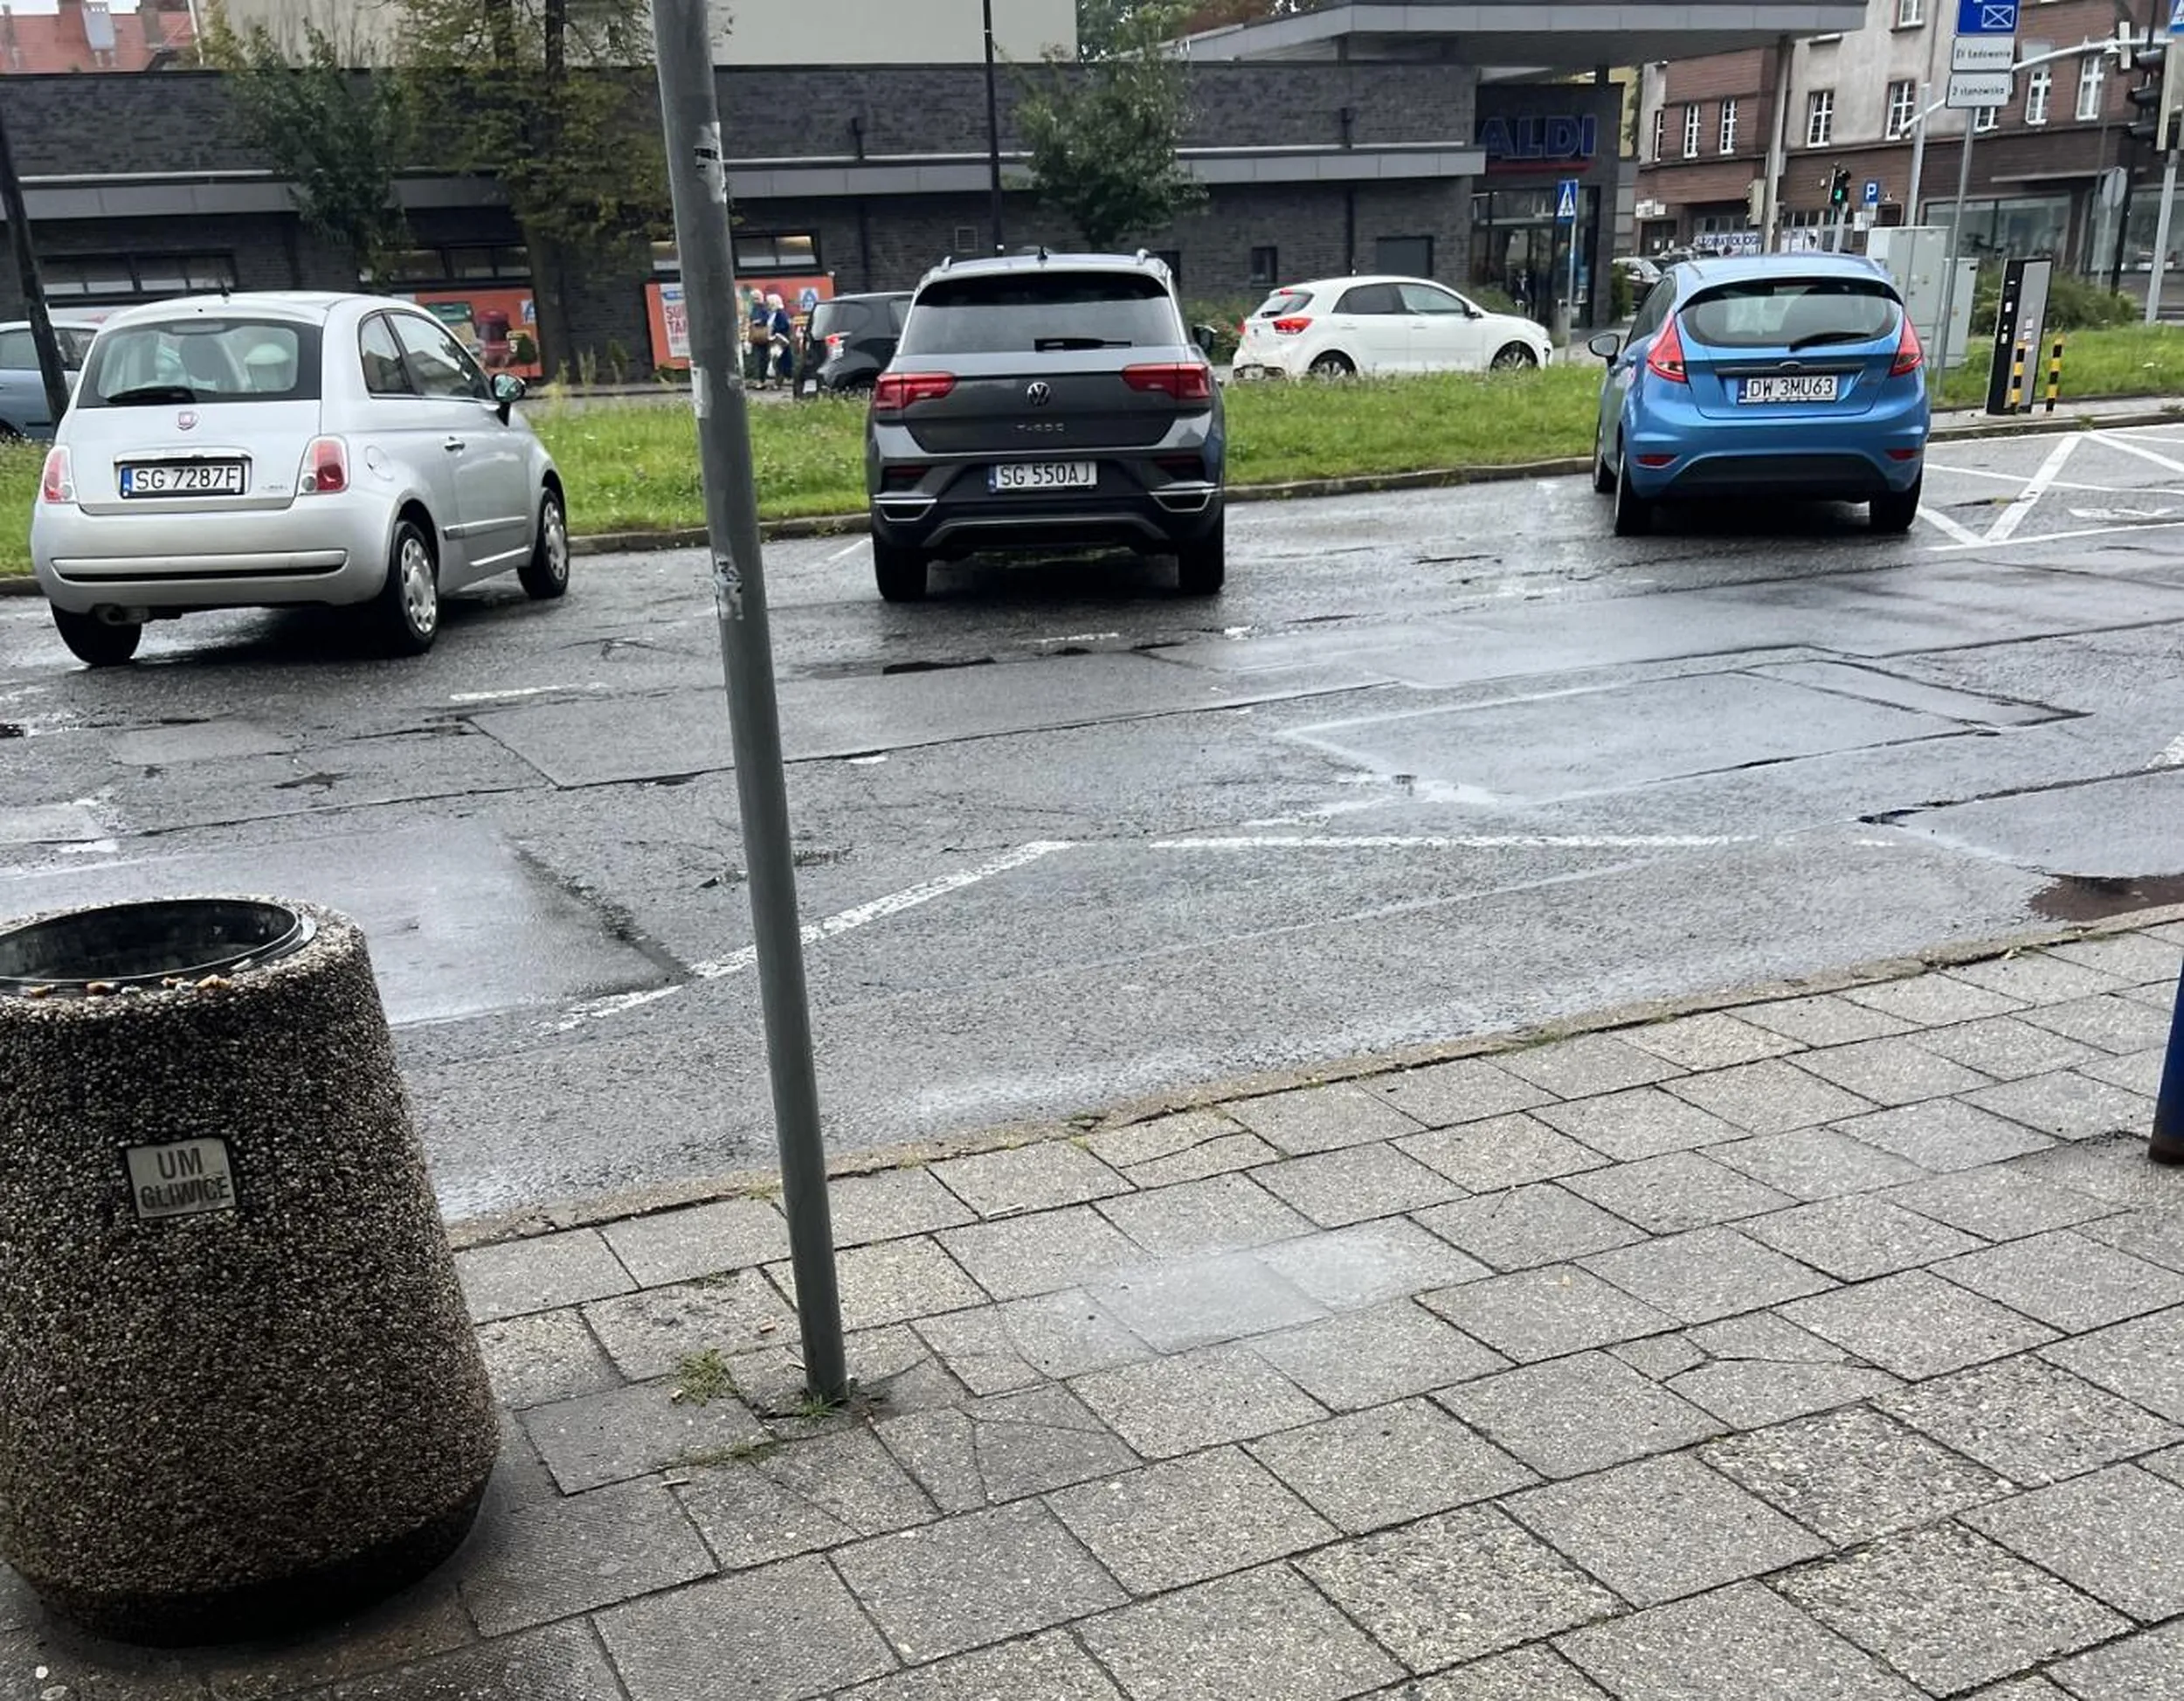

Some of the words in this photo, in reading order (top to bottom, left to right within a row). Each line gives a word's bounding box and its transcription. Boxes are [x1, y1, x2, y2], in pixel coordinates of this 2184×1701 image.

[1480, 114, 1598, 158] ALDI
[1865, 183, 1877, 200] P
[1750, 379, 1773, 398] DW
[1780, 377, 1834, 396] 3MU63
[135, 469, 165, 490] SG
[171, 467, 239, 489] 7287F
[1001, 467, 1025, 487] SG
[1032, 463, 1089, 485] 550AJ
[156, 1147, 204, 1180] UM
[141, 1171, 232, 1210] GLIWICE
